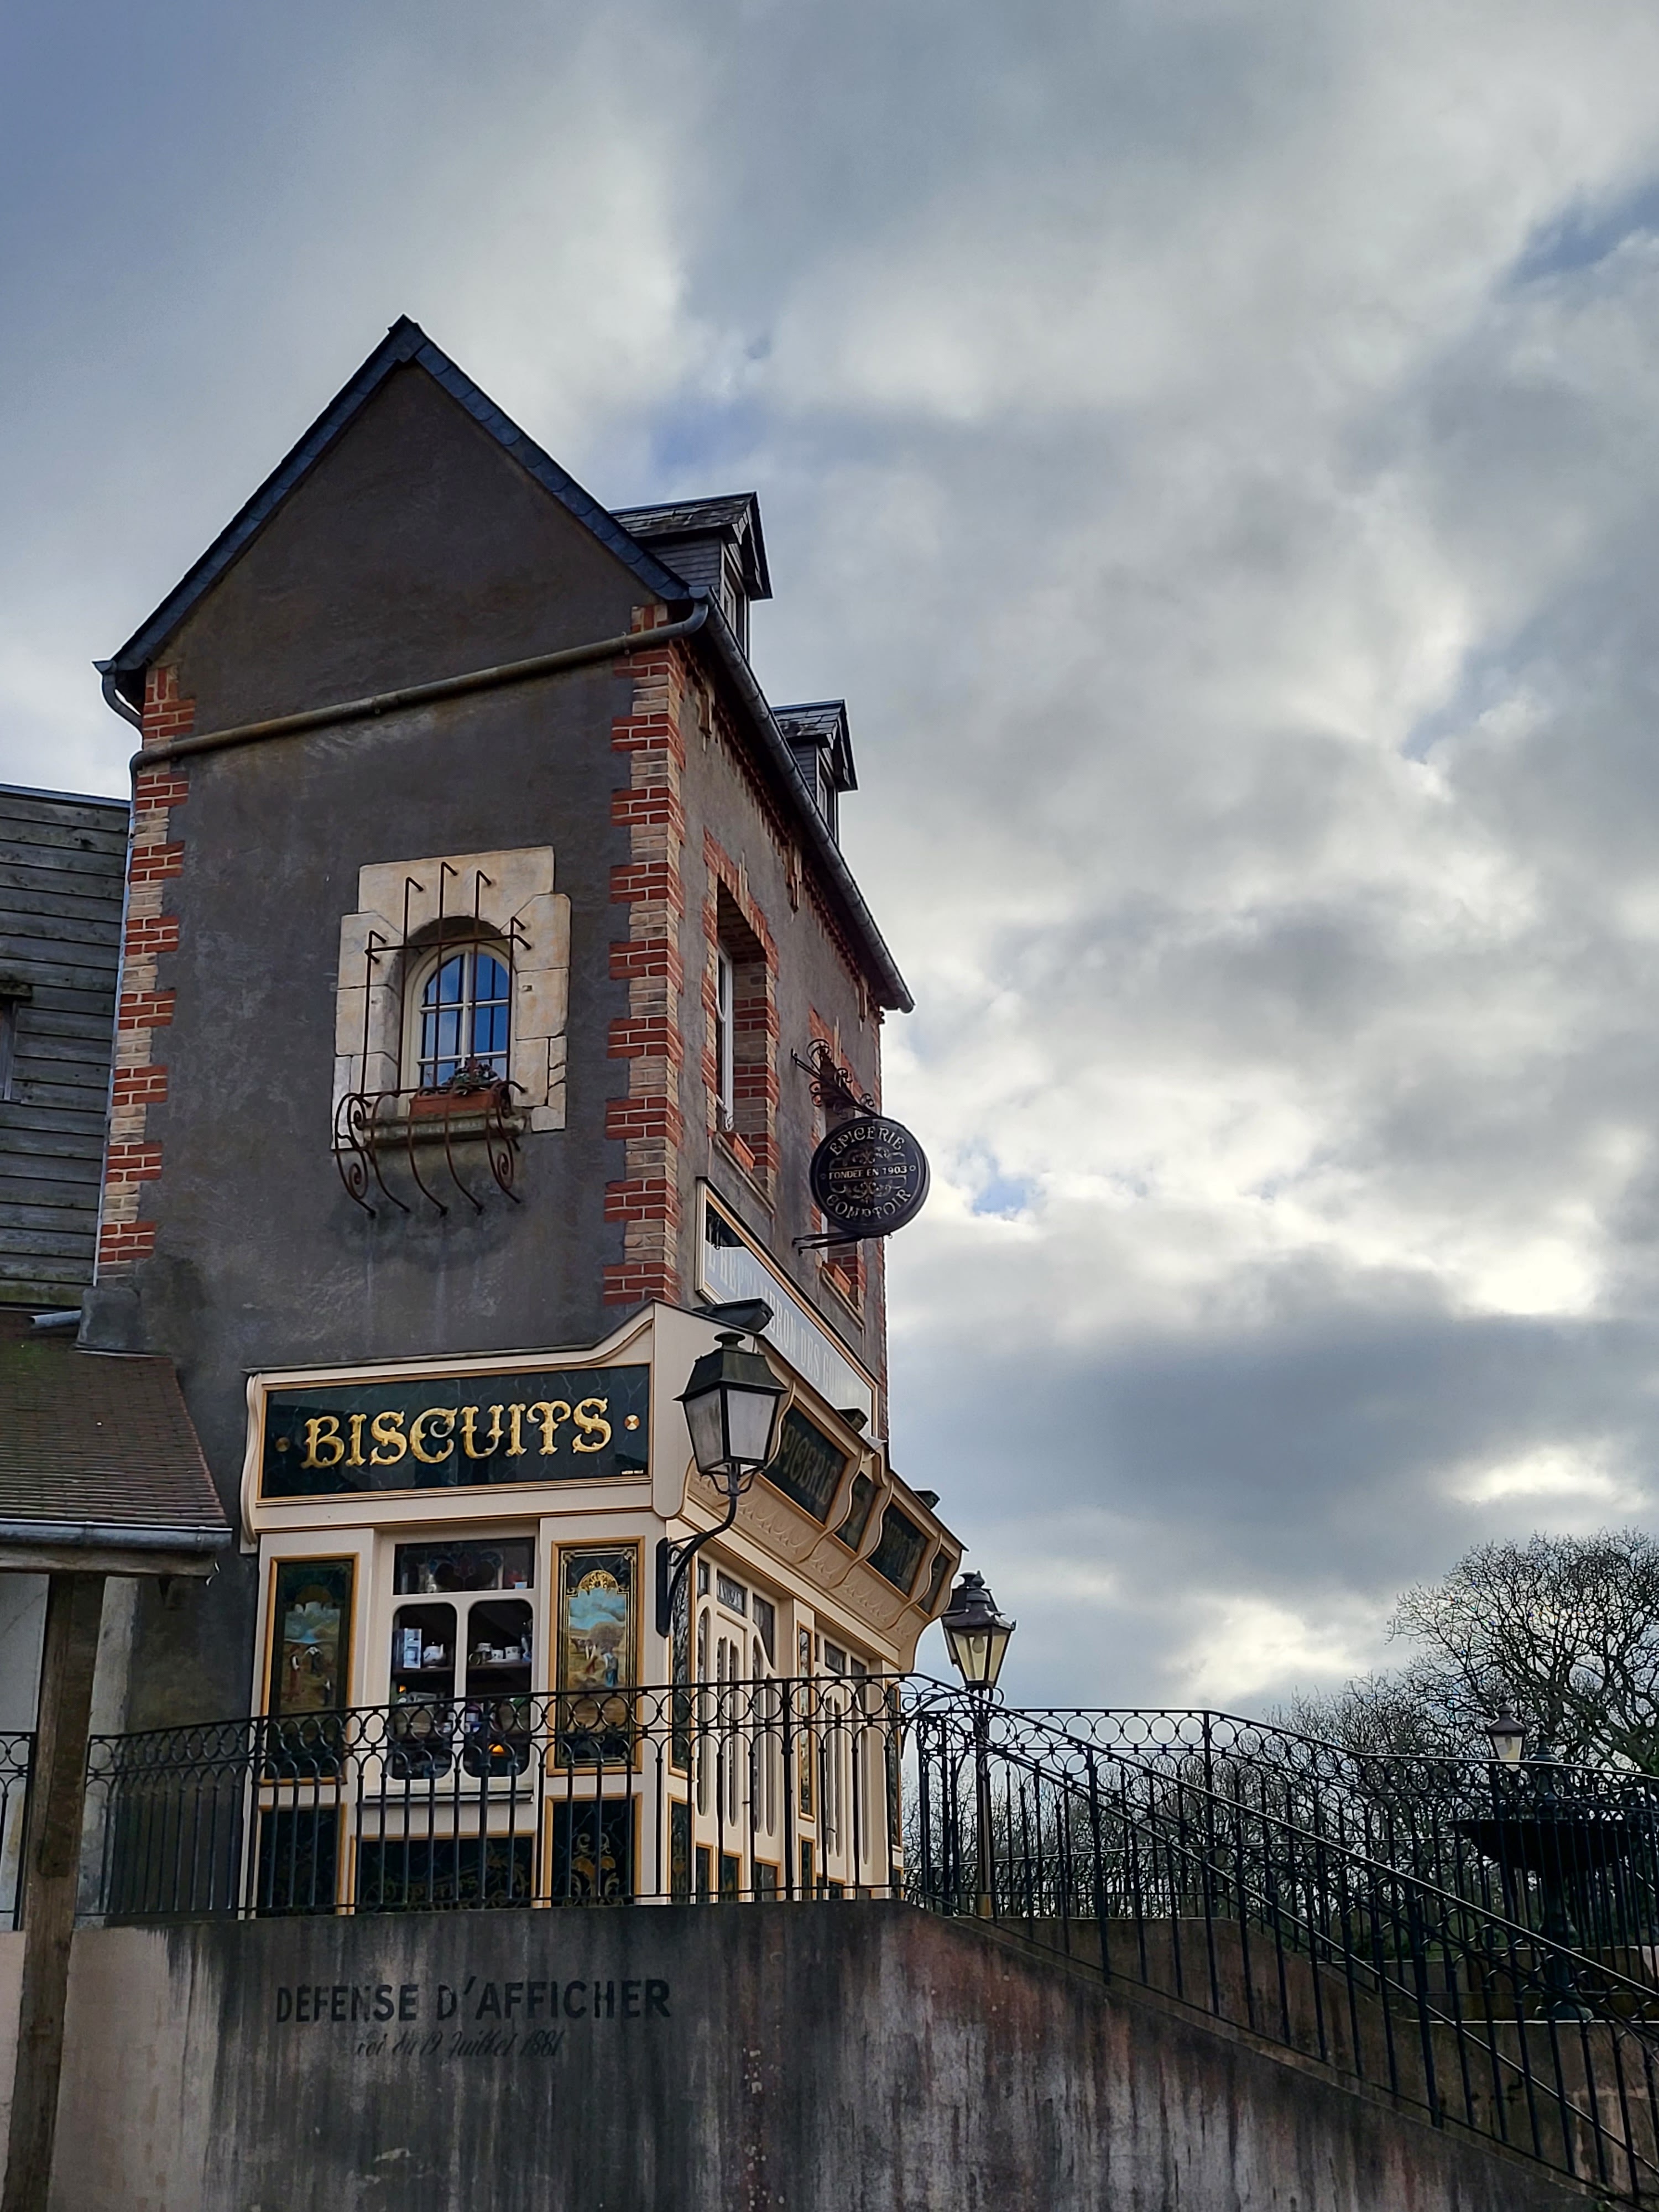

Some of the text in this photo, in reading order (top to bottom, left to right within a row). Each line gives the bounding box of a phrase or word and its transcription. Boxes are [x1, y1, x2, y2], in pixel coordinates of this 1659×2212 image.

[866, 1167, 880, 1176] EN
[300, 1396, 613, 1469] BISCUITS
[437, 1975, 671, 2021] D'AFFICHER
